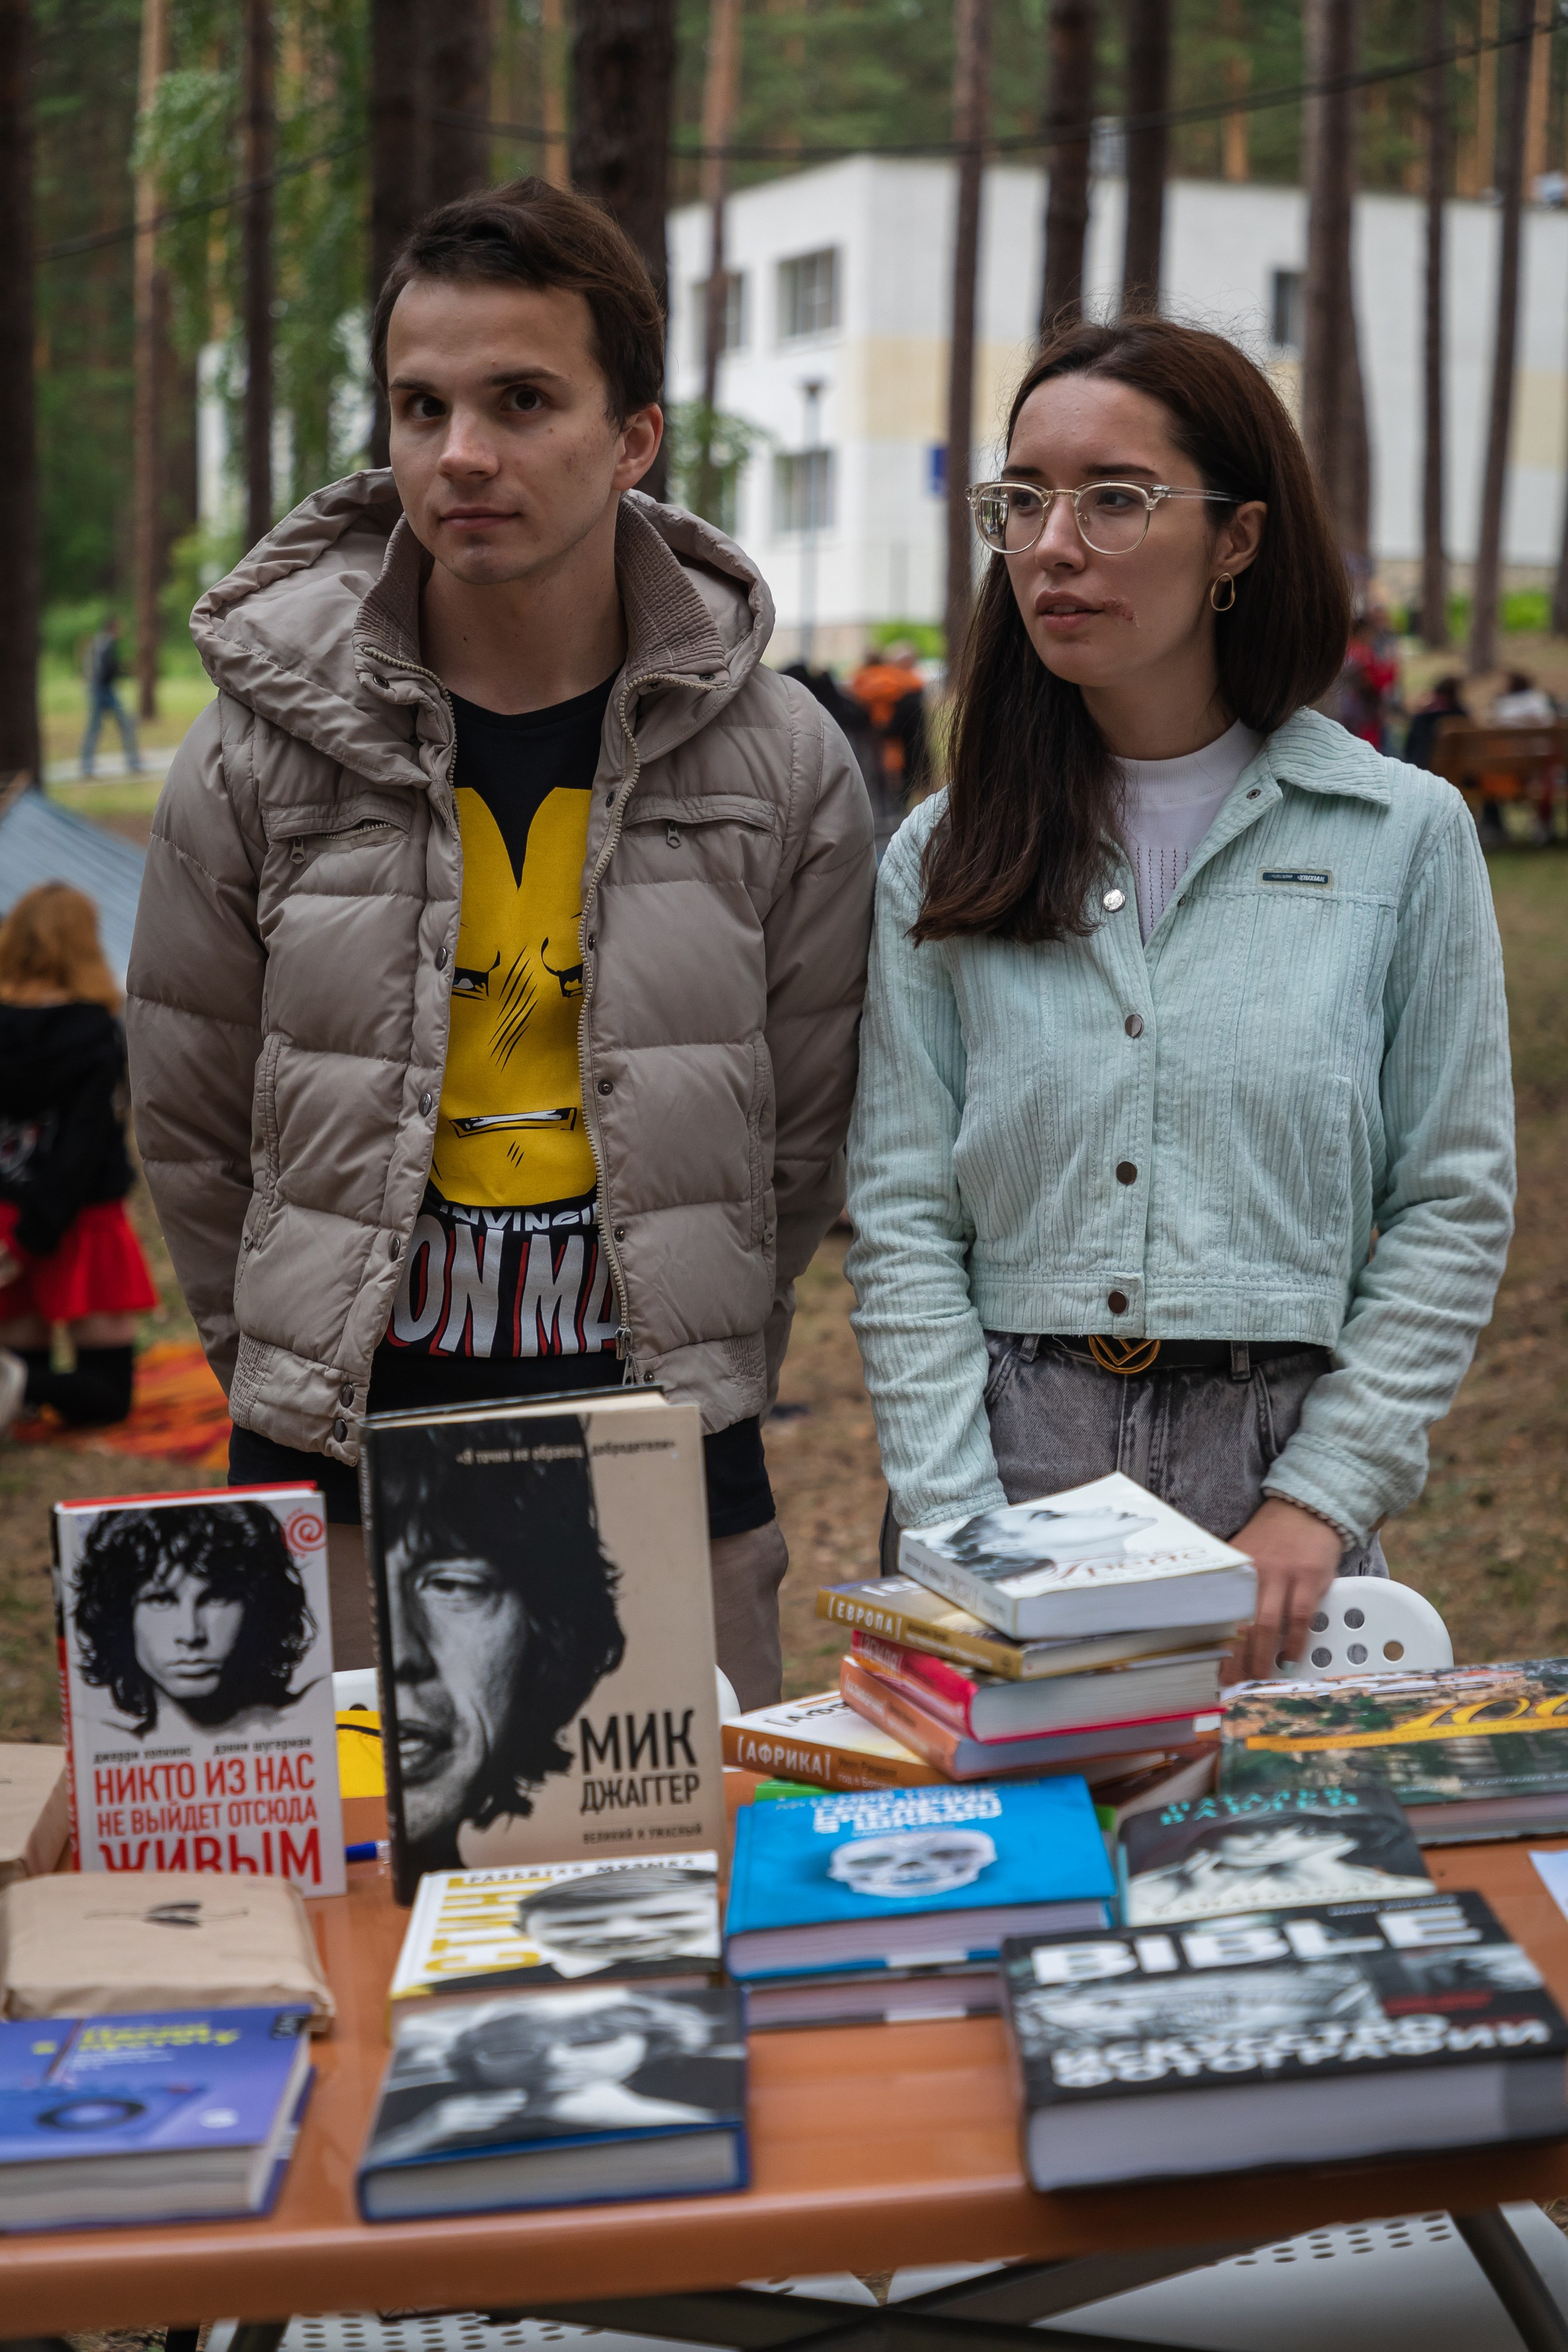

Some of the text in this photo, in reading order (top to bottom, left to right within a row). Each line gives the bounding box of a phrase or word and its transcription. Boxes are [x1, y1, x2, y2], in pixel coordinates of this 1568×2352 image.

[579, 1709, 697, 1775] МИК
[737, 1735, 831, 1781] [АФРИКА]
[94, 1753, 315, 1807] НИКТО ИЗ НАС
[579, 1773, 701, 1817] ДЖАГГЕР
[97, 1795, 318, 1837] НЕ ВЫЙДЕТ ОТСЮДА
[583, 1822, 703, 1845] ВЕЛИКИЙ И УЖАСНЫЙ
[98, 1827, 323, 1885] ЖИВЫМ
[1030, 1904, 1483, 1985] BIBLE
